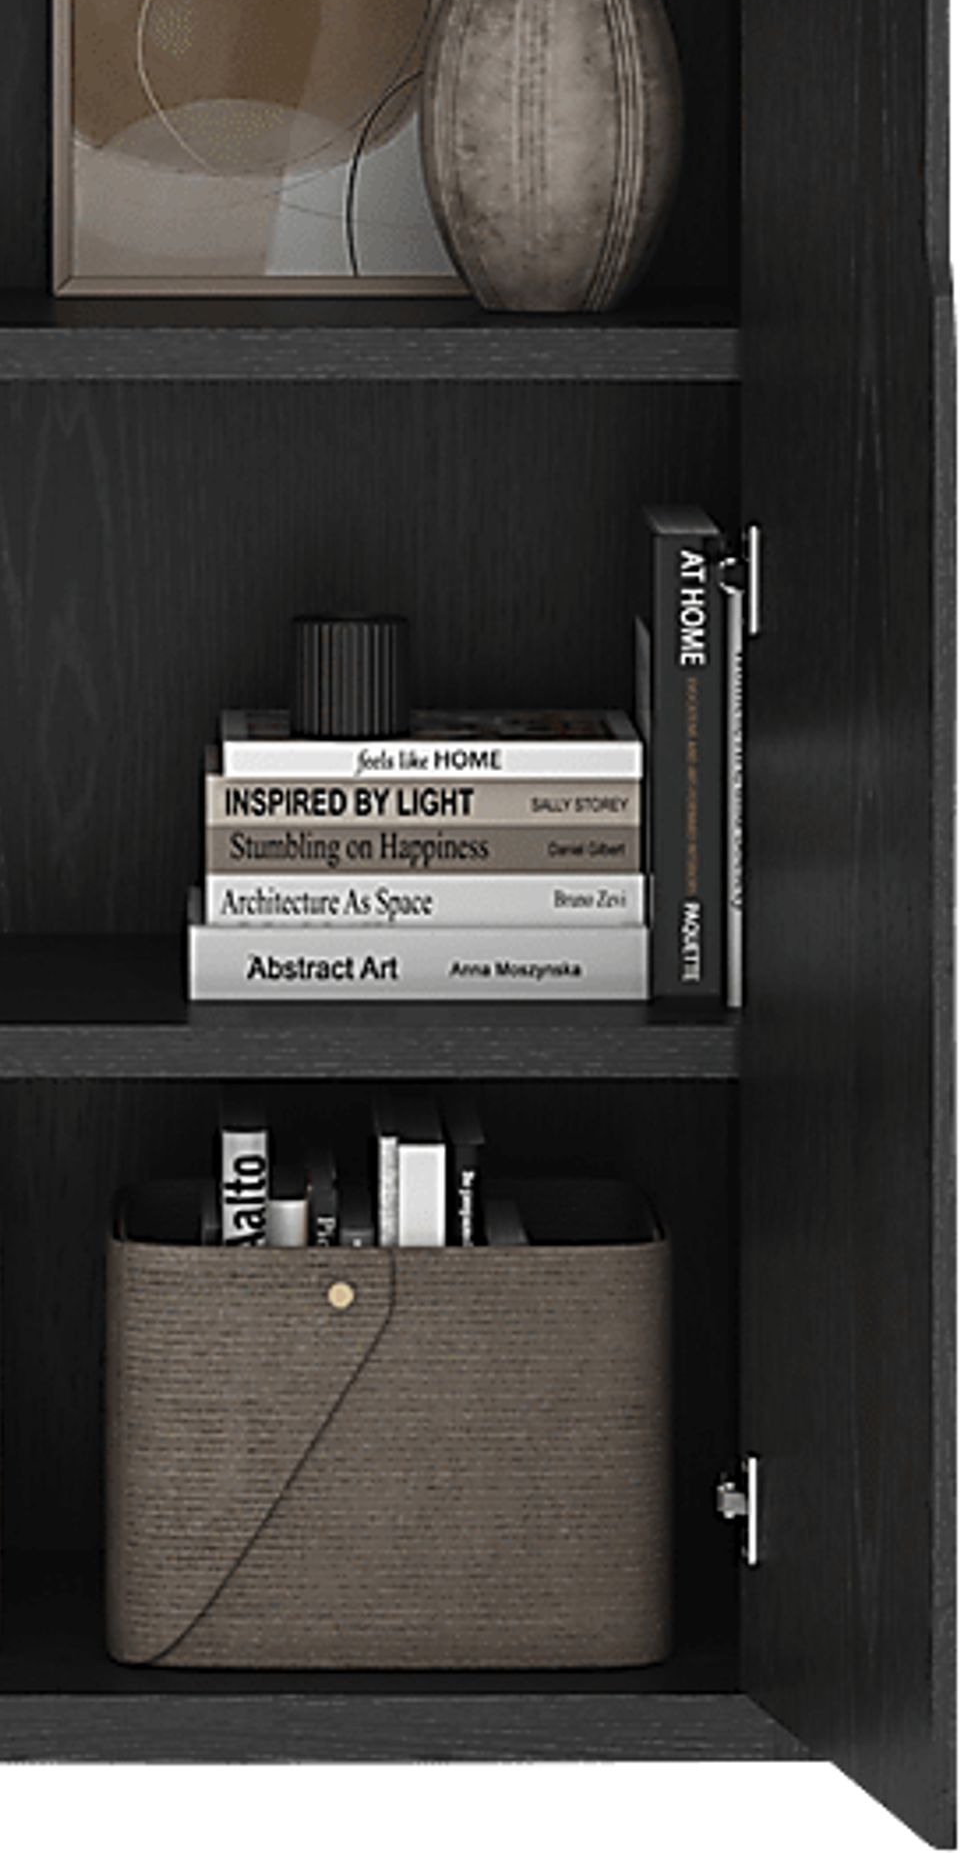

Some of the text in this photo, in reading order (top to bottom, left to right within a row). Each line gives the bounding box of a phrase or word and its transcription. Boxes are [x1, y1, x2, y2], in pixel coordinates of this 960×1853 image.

[680, 549, 707, 666] AT HOME
[354, 748, 503, 777] feels like HOME
[225, 787, 475, 817] INSPIRED BY LIGHT
[531, 797, 630, 813] SALLY STOREY
[229, 830, 490, 869] Stumbling on Happiness
[220, 886, 433, 922] Architecture As Space
[246, 955, 399, 980] Abstract Art
[449, 961, 492, 977] Anna
